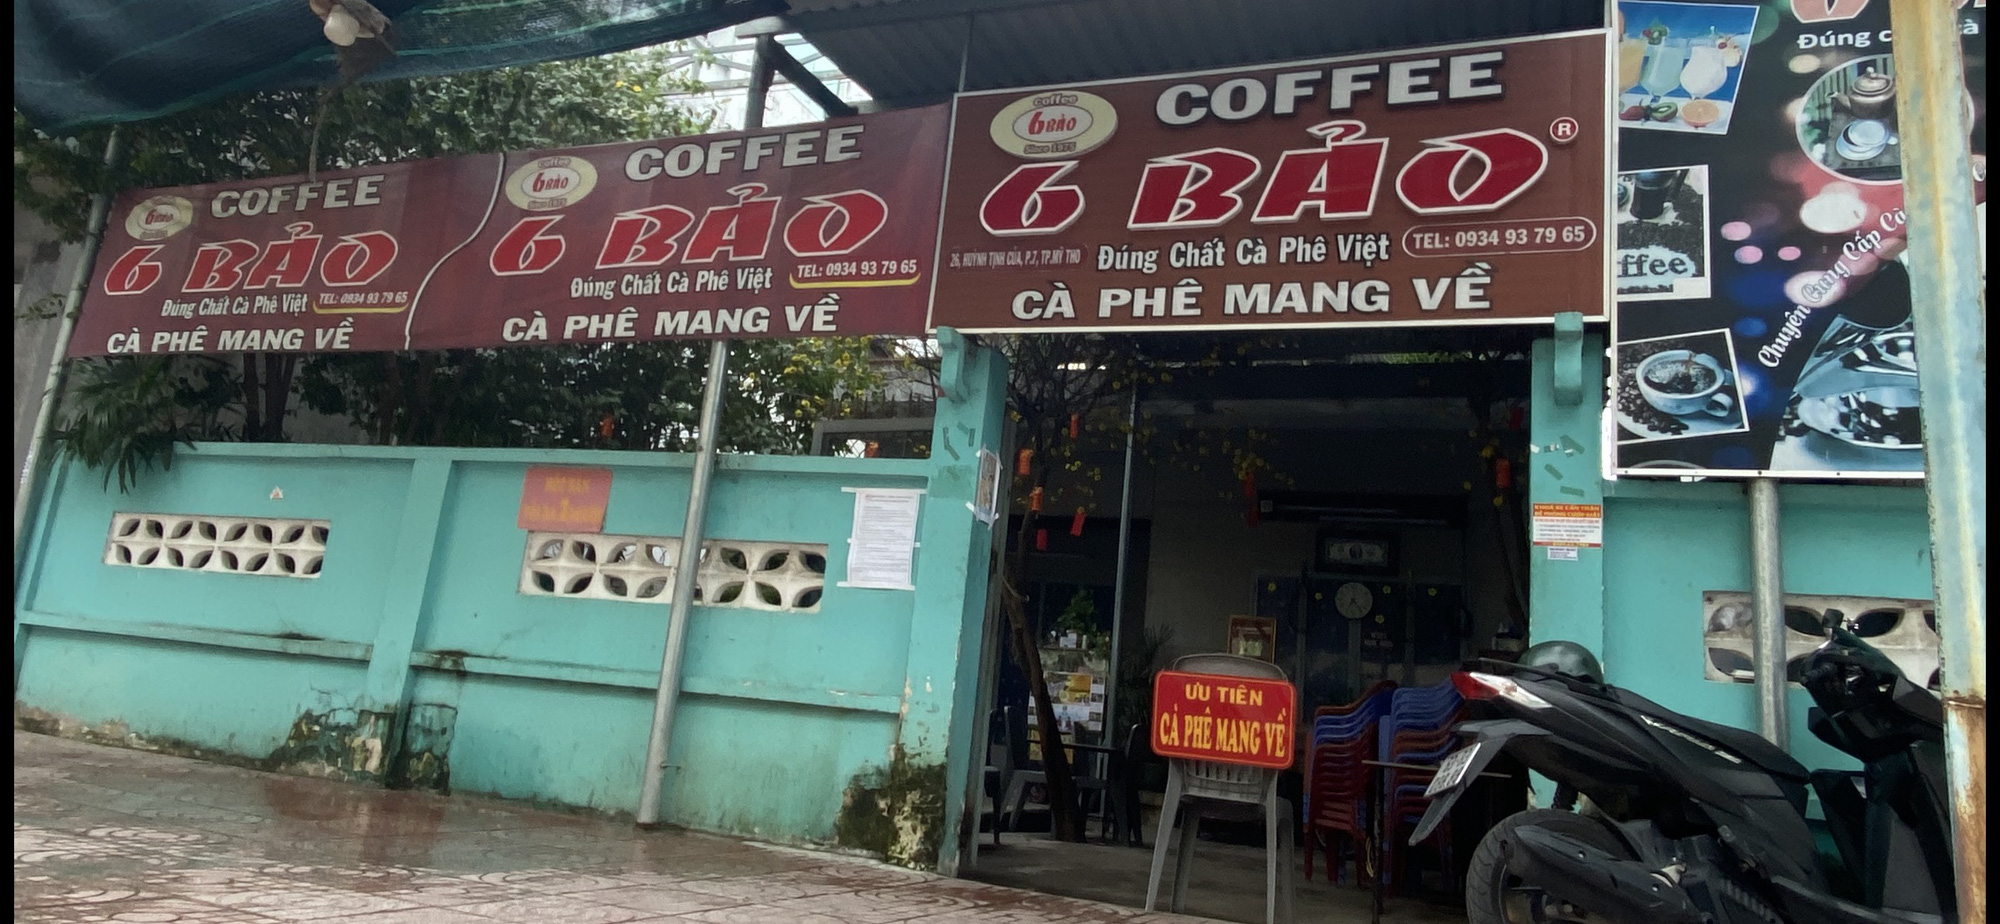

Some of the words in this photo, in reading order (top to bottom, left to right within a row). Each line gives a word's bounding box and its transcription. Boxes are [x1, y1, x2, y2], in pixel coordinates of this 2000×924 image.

[1797, 30, 1871, 49] Đúng
[1033, 93, 1078, 107] coffee
[1156, 51, 1504, 126] COFFEE
[625, 124, 864, 181] COFFEE
[211, 175, 386, 219] COFFEE
[979, 160, 1085, 235] 6
[1126, 119, 1549, 231] BẢO
[490, 214, 566, 276] 6
[595, 182, 889, 269] BẢO
[1413, 231, 1450, 249] TEL:
[1454, 230, 1499, 247] 0934
[1505, 228, 1528, 245] 93
[1533, 227, 1557, 244] 79
[1562, 225, 1585, 242] 65
[104, 244, 164, 295] 6
[182, 221, 398, 293] BẢO
[797, 262, 823, 278] TEL:
[826, 262, 857, 276] 0934
[861, 261, 877, 275] 93
[881, 260, 898, 274] 79
[900, 259, 917, 273] 65
[1098, 244, 1157, 273] Đúng
[1169, 237, 1225, 269] Chất
[1236, 237, 1267, 264] Cà
[1279, 235, 1326, 263] Phê
[1337, 233, 1390, 267] Việt
[366, 292, 380, 303] 93
[381, 292, 393, 303] 79
[394, 290, 408, 303] 65
[571, 277, 615, 299] Đúng
[620, 271, 661, 296] Chất
[667, 270, 688, 293] Cà
[695, 268, 729, 292] Phê
[737, 267, 772, 295] Việt
[1011, 282, 1076, 320] CÀ
[1099, 278, 1202, 317] PHÊ
[1224, 279, 1391, 315] MANG
[1412, 261, 1492, 311] VỀ
[1758, 305, 1811, 368] Chuyên
[1801, 260, 1851, 303] Cung
[1843, 230, 1881, 260] Cấp
[161, 298, 196, 319] Đúng
[199, 296, 229, 316] Chất
[232, 297, 249, 315] Cà
[253, 294, 277, 314] Phê
[281, 294, 308, 317] Việt
[502, 311, 548, 342] CÀ
[563, 307, 639, 339] PHÊ
[654, 307, 770, 336] MANG
[785, 293, 841, 332] VỀ
[107, 327, 141, 354] CÀ
[151, 325, 208, 352] PHÊ
[217, 328, 304, 351] MANG
[315, 317, 354, 349] VỀ
[1185, 682, 1211, 701] ƯU
[1217, 685, 1262, 706] TIÊN
[1160, 703, 1180, 747] CÀ
[1183, 706, 1212, 749] PHÊ
[1216, 718, 1261, 755] MANG
[1264, 708, 1286, 757] VỀ
